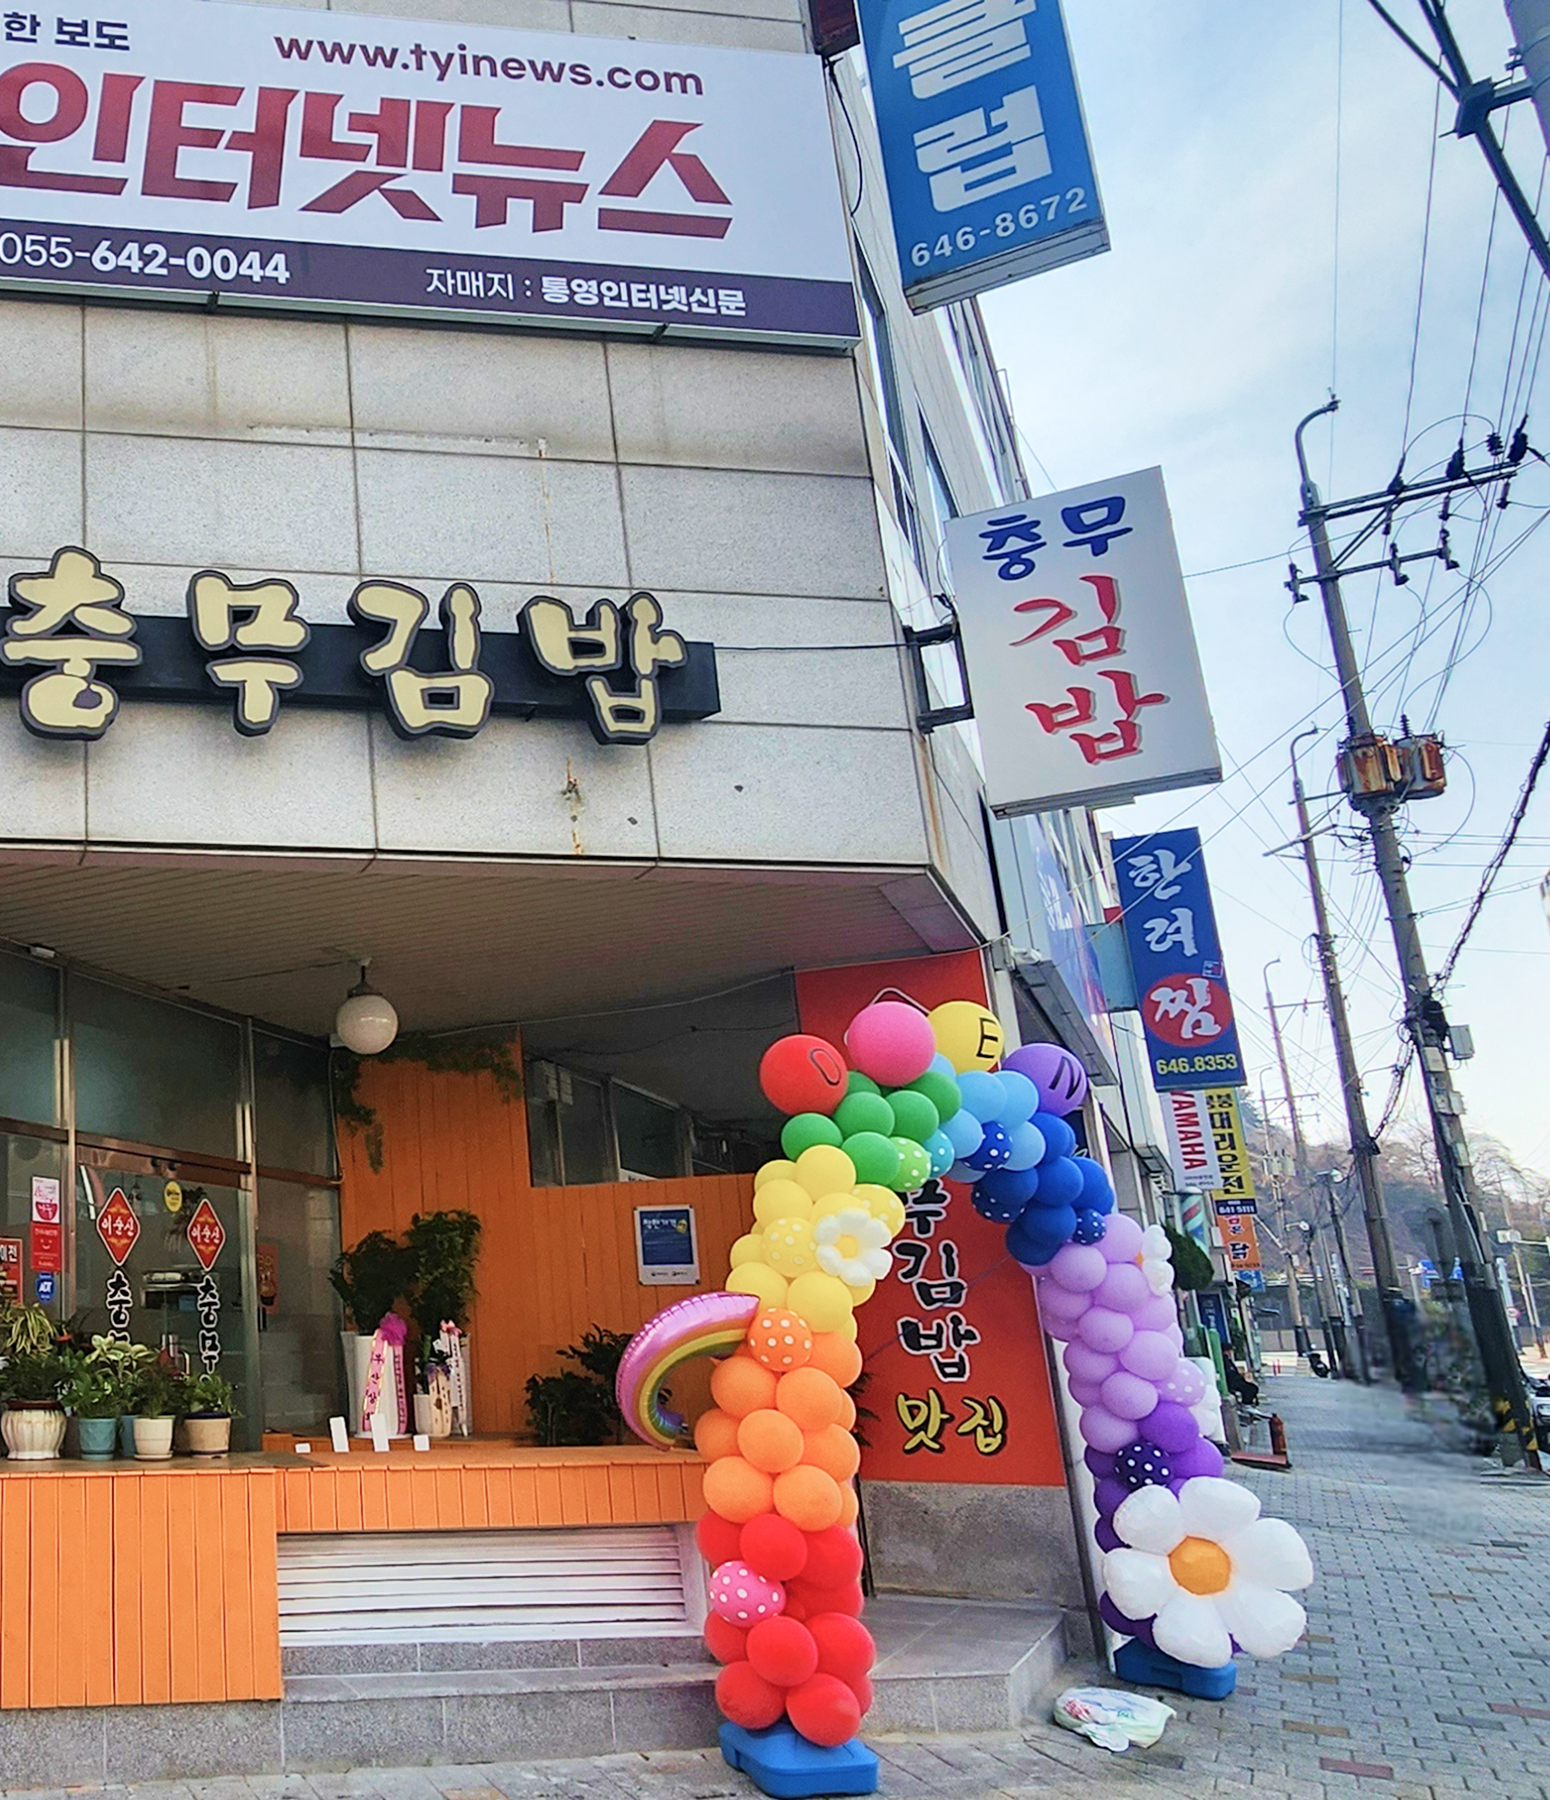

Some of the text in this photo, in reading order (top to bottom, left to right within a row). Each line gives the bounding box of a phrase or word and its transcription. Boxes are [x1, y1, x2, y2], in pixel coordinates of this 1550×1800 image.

[55, 16, 131, 52] 보도
[273, 36, 704, 96] www.tyinews.com
[910, 186, 1088, 268] 646-8672
[425, 267, 515, 301] 자매지
[540, 275, 747, 316] 통영인터넷신문
[978, 496, 1134, 581] 충무
[1008, 575, 1170, 766] 김밥
[1156, 1053, 1238, 1075] 646.8353
[1170, 1090, 1208, 1171] YAMAHA
[1209, 1111, 1246, 1196] 대리운전
[101, 1215, 135, 1236] 이순신
[191, 1222, 221, 1244] 이순신
[196, 1275, 221, 1382] 충무
[896, 1389, 1008, 1455] 맛집
